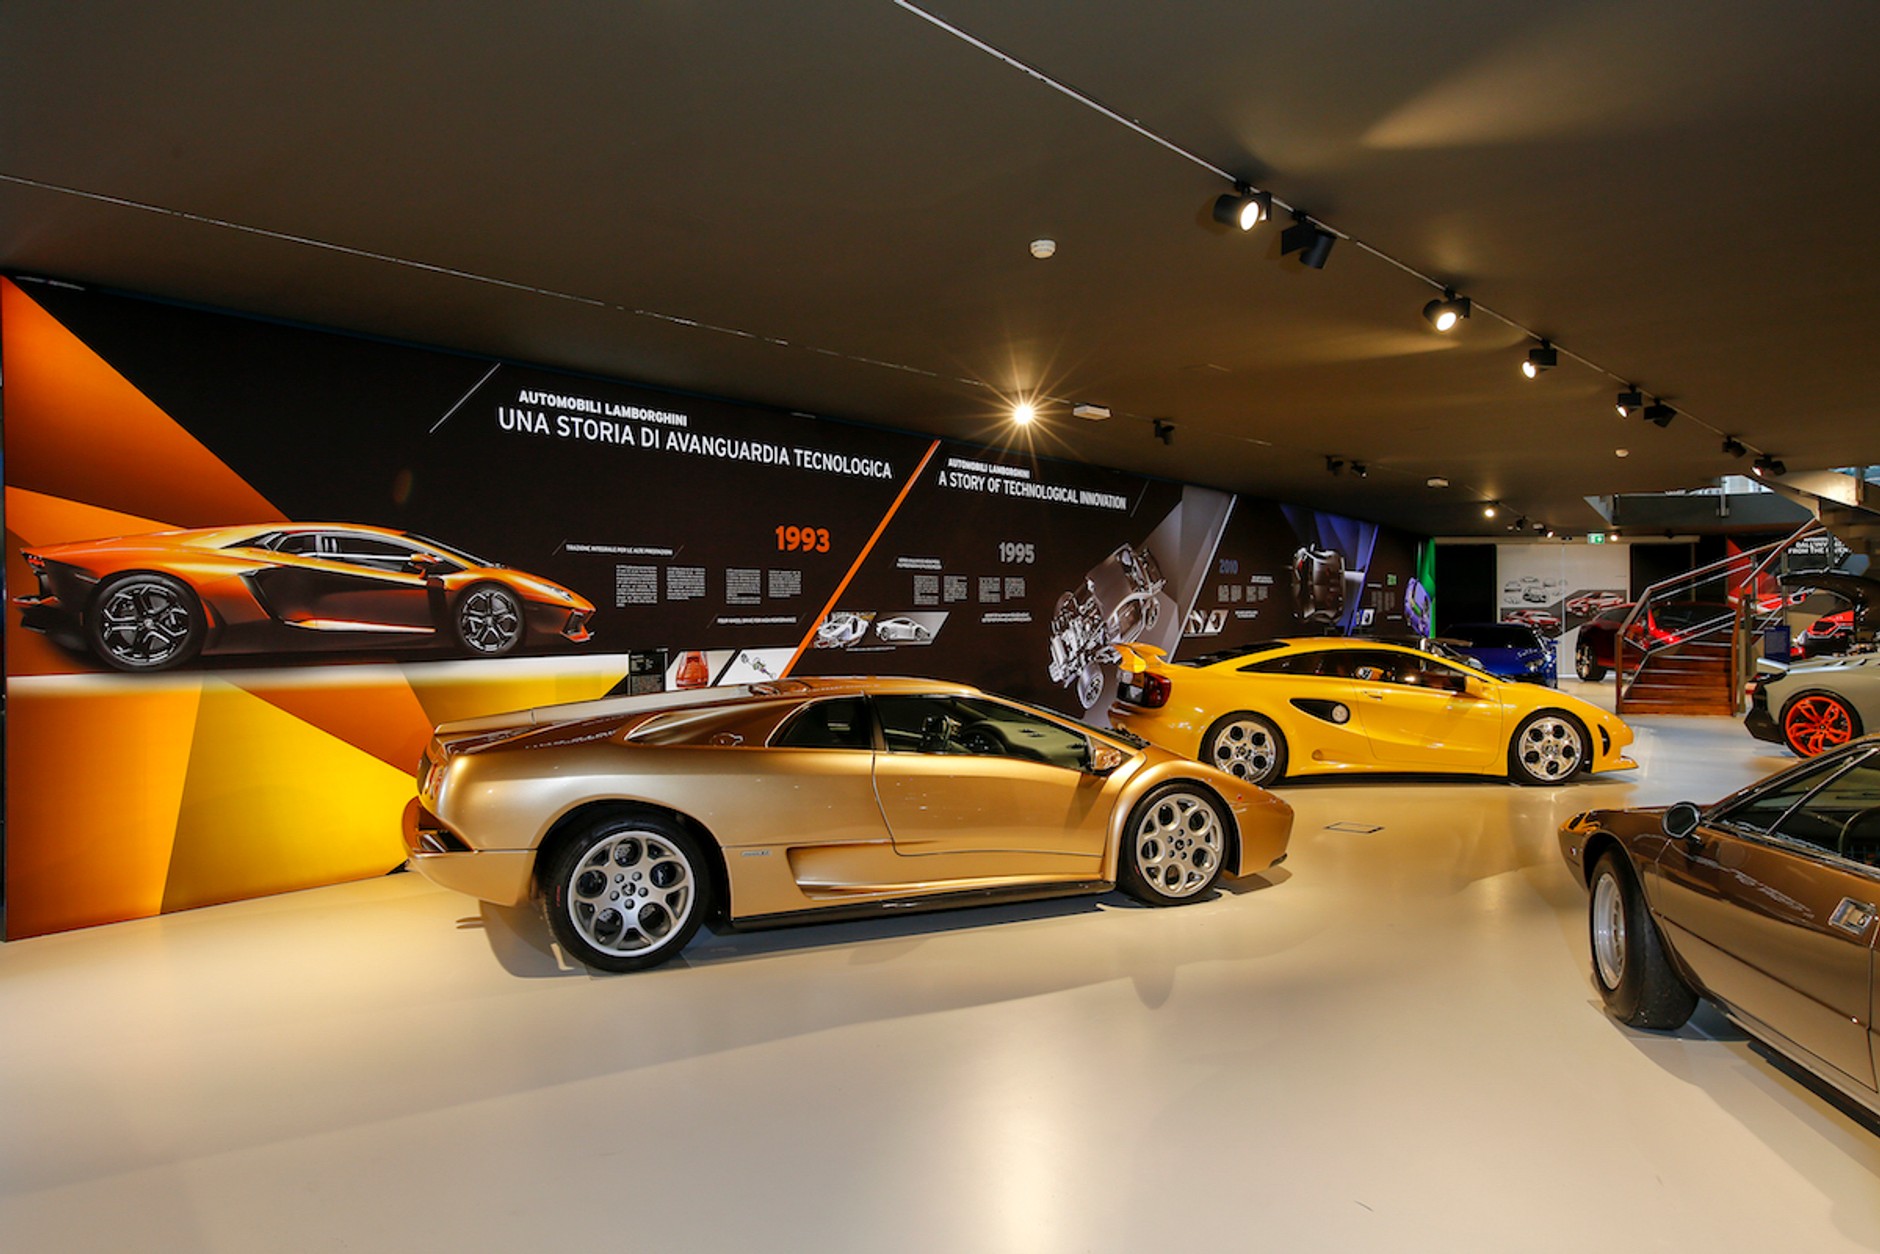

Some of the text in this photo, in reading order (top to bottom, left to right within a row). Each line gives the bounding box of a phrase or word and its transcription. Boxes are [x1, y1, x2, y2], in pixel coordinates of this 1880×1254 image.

[519, 390, 688, 427] AUTOMOBILI LAMBORGHINI
[499, 407, 892, 479] UNA STORIA DI AVANGUARDIA TECNOLOGICA
[948, 457, 1031, 479] AUTOMOBILI LAMBORGHINI
[938, 470, 1127, 510] A STORY OF TECHNOLOGICAL INNOVATION
[775, 525, 831, 553] 1993
[999, 542, 1035, 564] 1995
